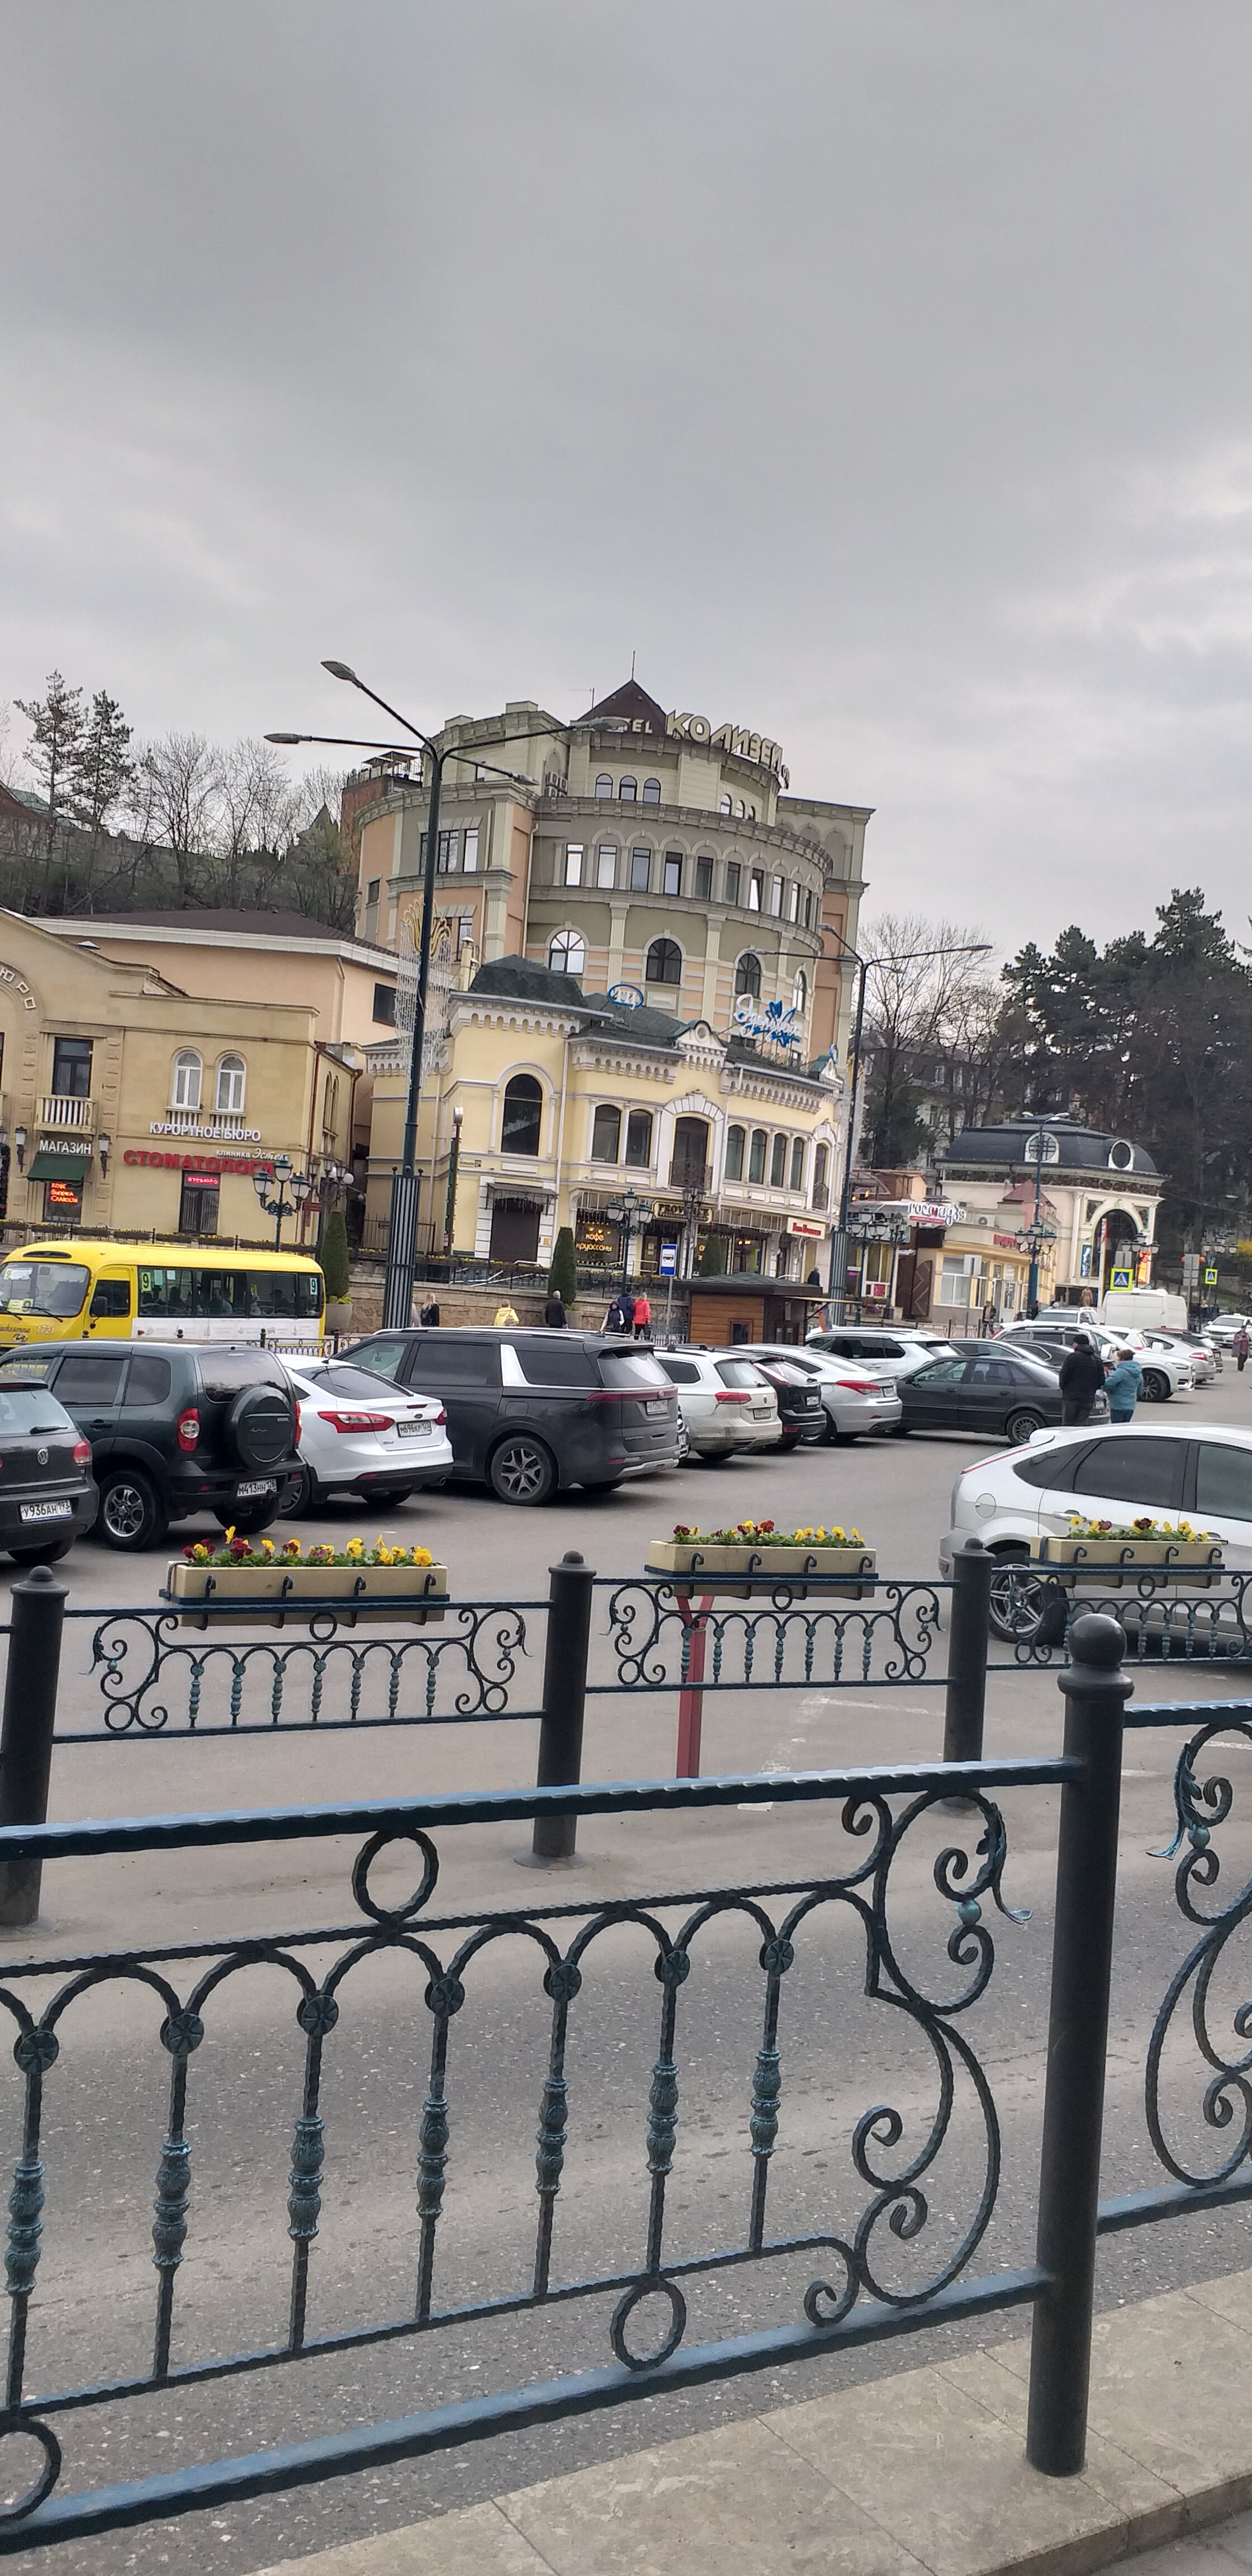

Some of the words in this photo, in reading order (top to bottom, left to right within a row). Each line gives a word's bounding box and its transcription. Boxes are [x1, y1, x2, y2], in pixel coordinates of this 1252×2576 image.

[0, 968, 36, 1010] ЮРО
[149, 1121, 221, 1139] КУРОРТНОЕ
[224, 1128, 262, 1142] БЮРО
[40, 1139, 92, 1154] МАГАЗИН
[216, 1149, 250, 1158] клиника
[123, 1149, 276, 1176] СТОМАТОЛОГИ
[585, 1232, 604, 1242] кофе
[143, 1273, 149, 1288] 9
[311, 1279, 316, 1292] 9
[37, 1325, 55, 1334] 1721
